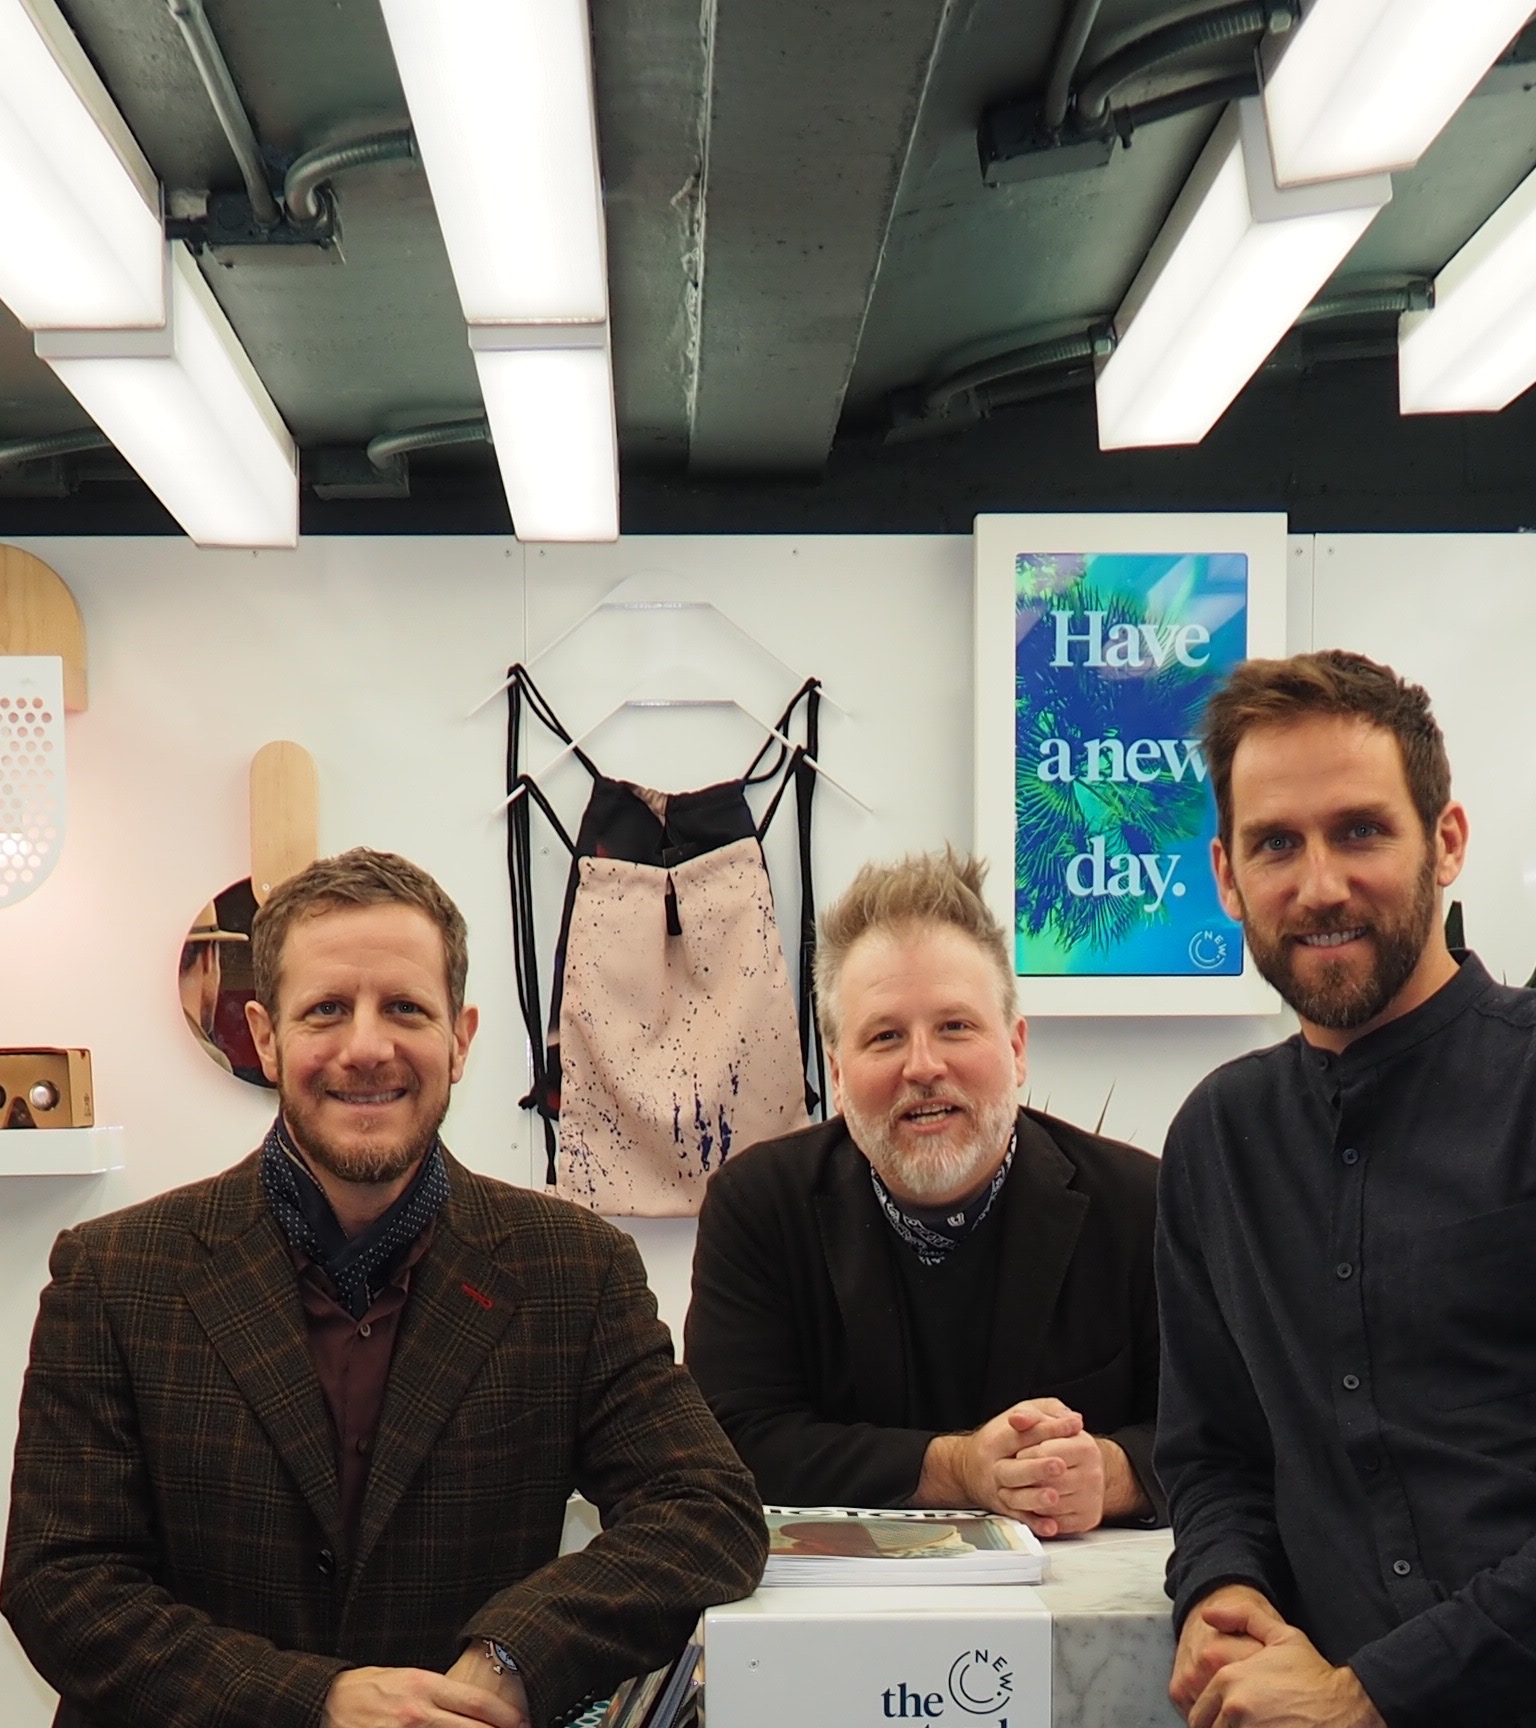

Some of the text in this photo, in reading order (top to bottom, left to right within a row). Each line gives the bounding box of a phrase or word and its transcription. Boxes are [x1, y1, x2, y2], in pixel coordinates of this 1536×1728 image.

[1048, 609, 1211, 668] Have
[1037, 737, 1209, 783] a new
[1066, 836, 1187, 913] day.
[881, 1682, 945, 1718] the
